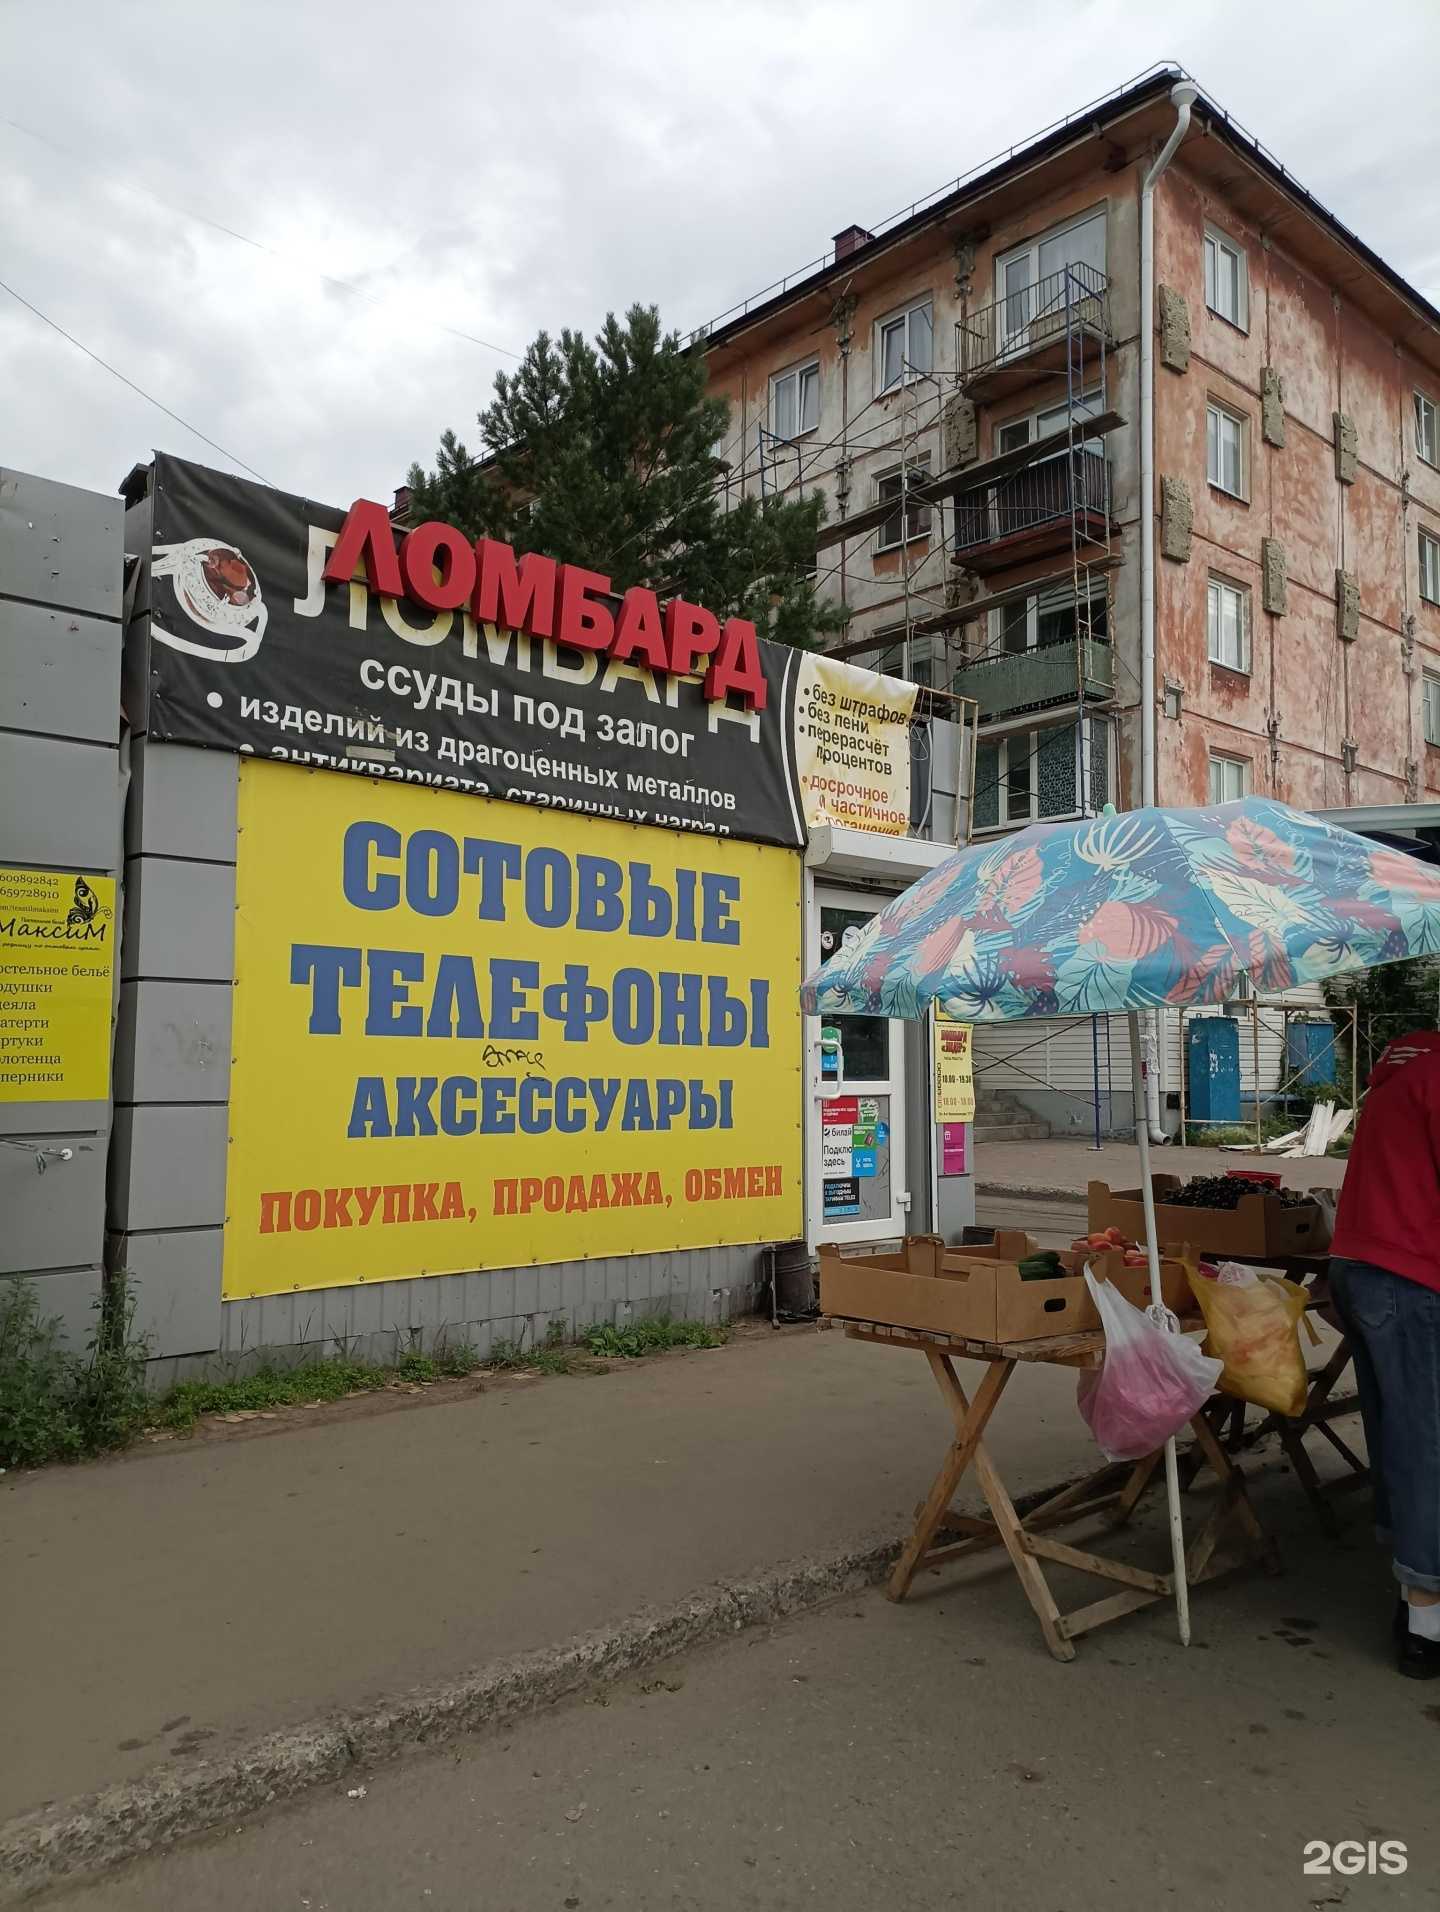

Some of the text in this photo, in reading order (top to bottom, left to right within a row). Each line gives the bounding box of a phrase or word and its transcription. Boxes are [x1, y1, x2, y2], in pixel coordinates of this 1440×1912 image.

[321, 498, 768, 711] ЛОМБАРД
[360, 658, 694, 757] ссуды под залог
[808, 702, 869, 734] без пени
[813, 684, 907, 725] без штрафов
[240, 695, 736, 810] изделий из драгоценных металлов
[808, 724, 889, 757] перерасчёт
[816, 745, 892, 775] процентов
[810, 775, 888, 803] досрочное
[831, 797, 905, 825] частичное
[343, 821, 740, 945] СОТОВЫЕ
[72, 964, 111, 977] бельё
[290, 943, 770, 1048] ТЕЛЕФОНЫ
[348, 1075, 734, 1138] АКСЕССУАРЫ
[259, 1165, 783, 1233] ПОКУПКА, ПРОДАЖА, ОБМЕН
